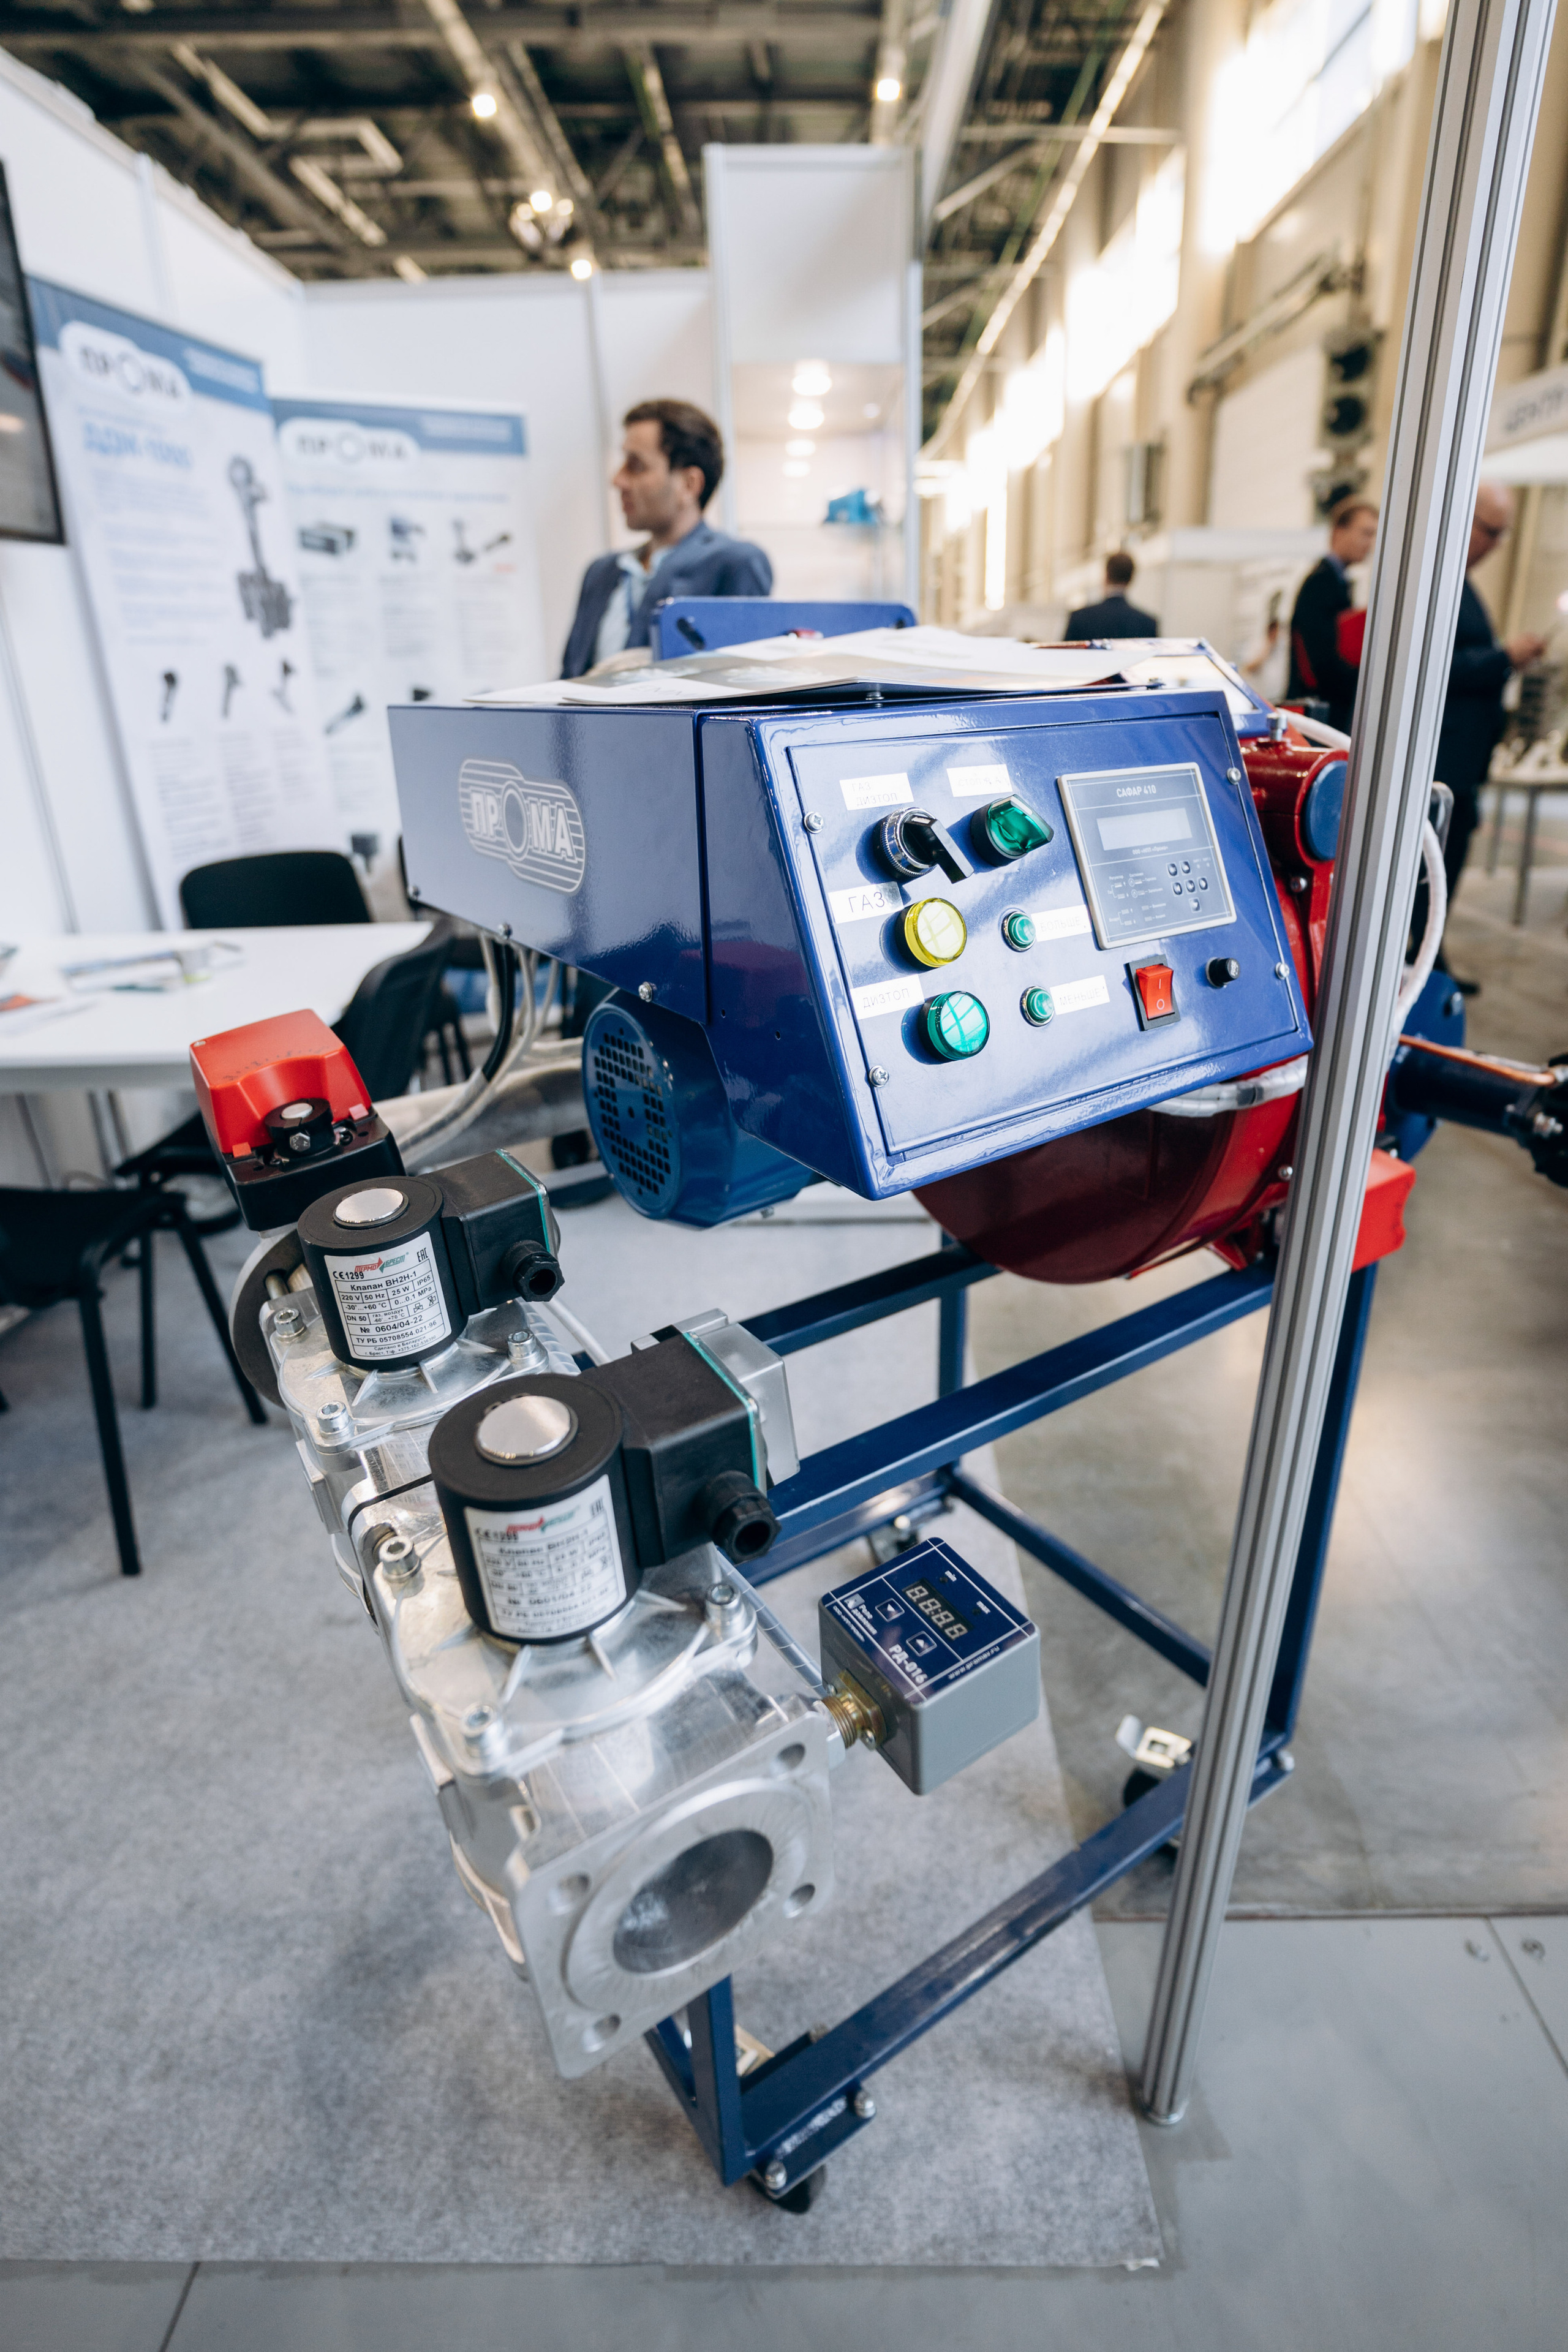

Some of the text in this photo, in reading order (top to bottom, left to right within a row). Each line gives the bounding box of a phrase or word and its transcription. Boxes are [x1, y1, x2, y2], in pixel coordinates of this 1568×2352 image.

[851, 782, 871, 792] ГАЗ
[1116, 785, 1156, 797] САФАР 410
[856, 792, 898, 807] ДИЗТОП
[470, 782, 577, 862] ПРОМА
[848, 891, 886, 913] ГАЗ
[1039, 916, 1081, 932] БОЛЬШЕ
[863, 987, 910, 1009] ДИЗТОП
[1059, 987, 1102, 1006] МЕНЬШЕ
[385, 1271, 417, 1287] ВН2Н-1
[417, 1275, 431, 1286] IP65
[418, 1286, 432, 1297] MPa
[375, 1314, 423, 1333] 0604/04-22
[379, 1320, 437, 1343] 05708554.021-96
[402, 1336, 426, 1346] Беларуси
[944, 1570, 957, 1582] min
[859, 1604, 873, 1619] Реле
[976, 1600, 991, 1615] max
[851, 1608, 878, 1635] давления
[888, 1643, 928, 1684] РД-016
